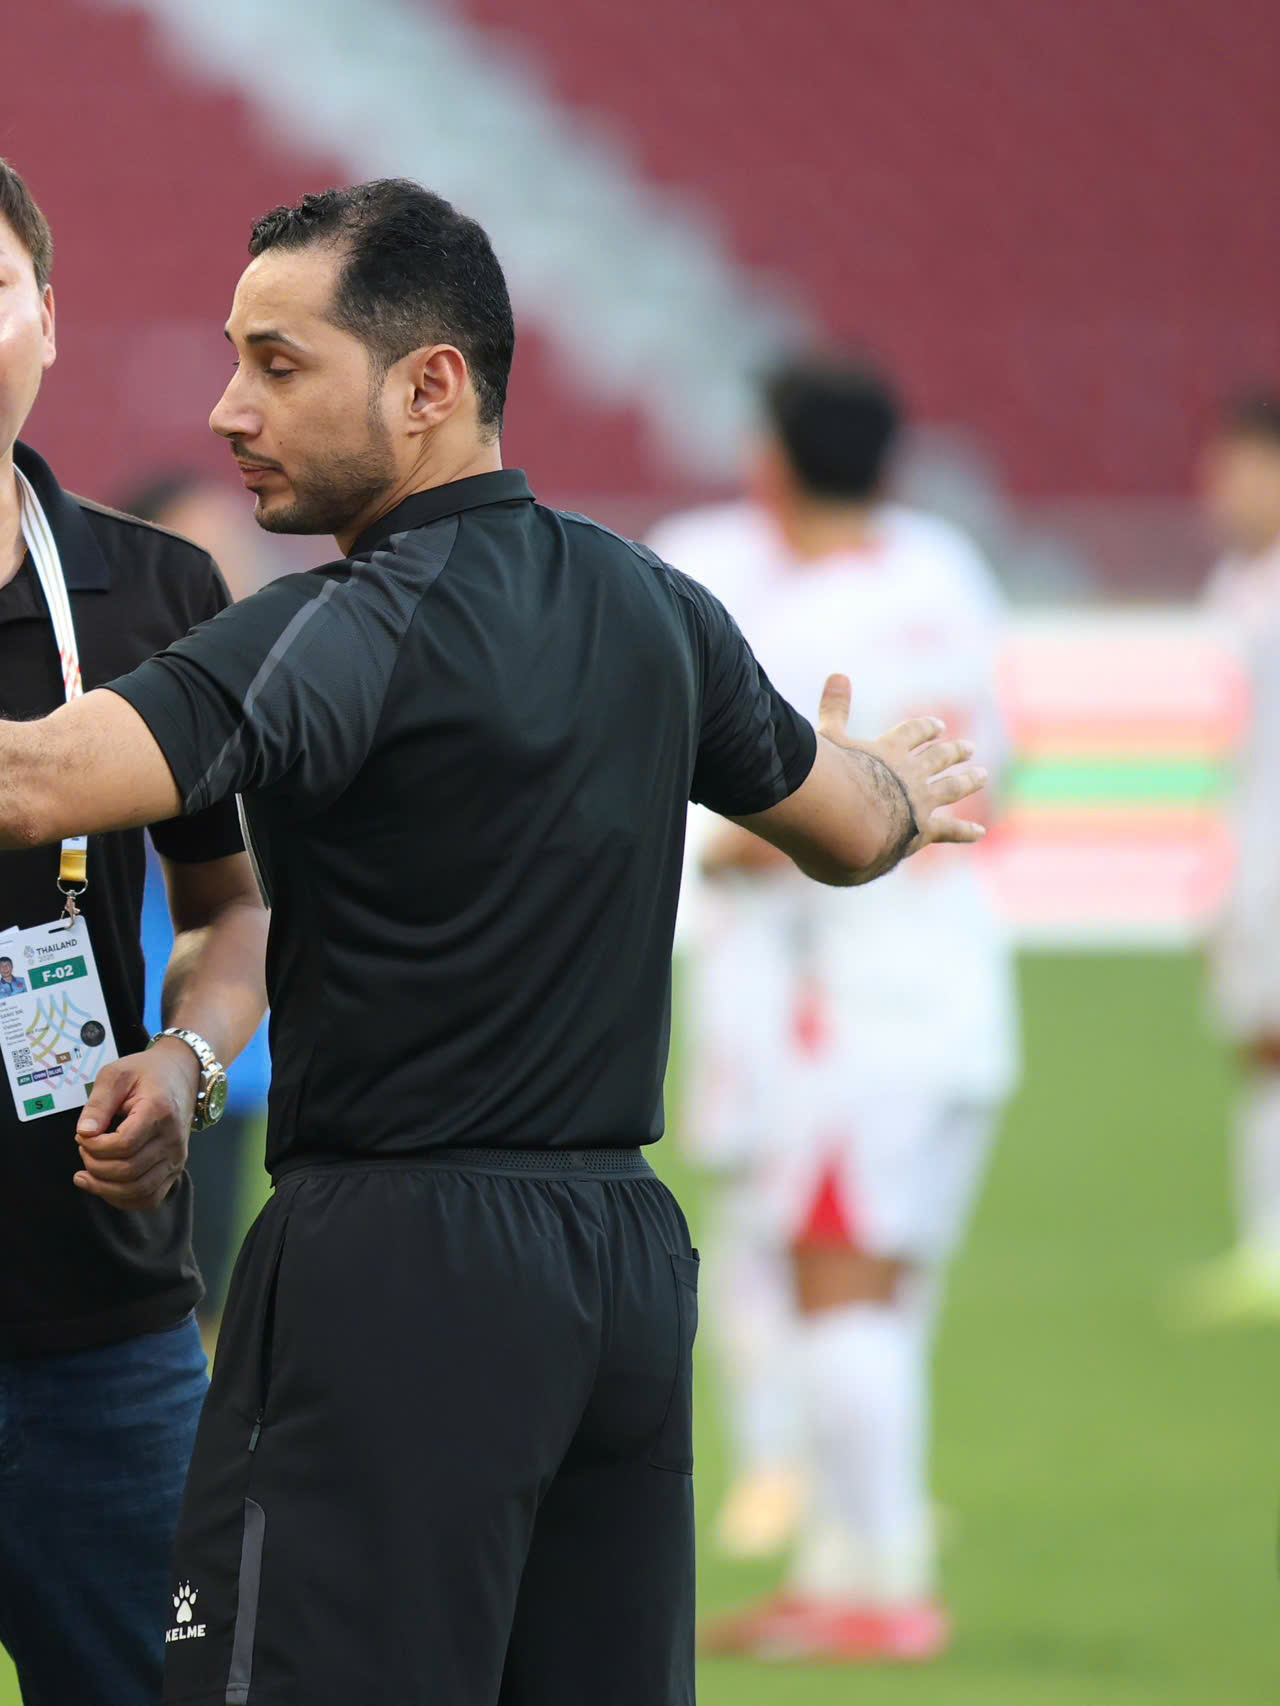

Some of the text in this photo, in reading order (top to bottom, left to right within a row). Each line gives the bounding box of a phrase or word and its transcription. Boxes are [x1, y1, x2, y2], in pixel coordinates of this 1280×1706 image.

[36, 939, 78, 955] THAILAND
[42, 964, 74, 983] F-02
[34, 1100, 44, 1110] S
[165, 1624, 207, 1643] KELME
